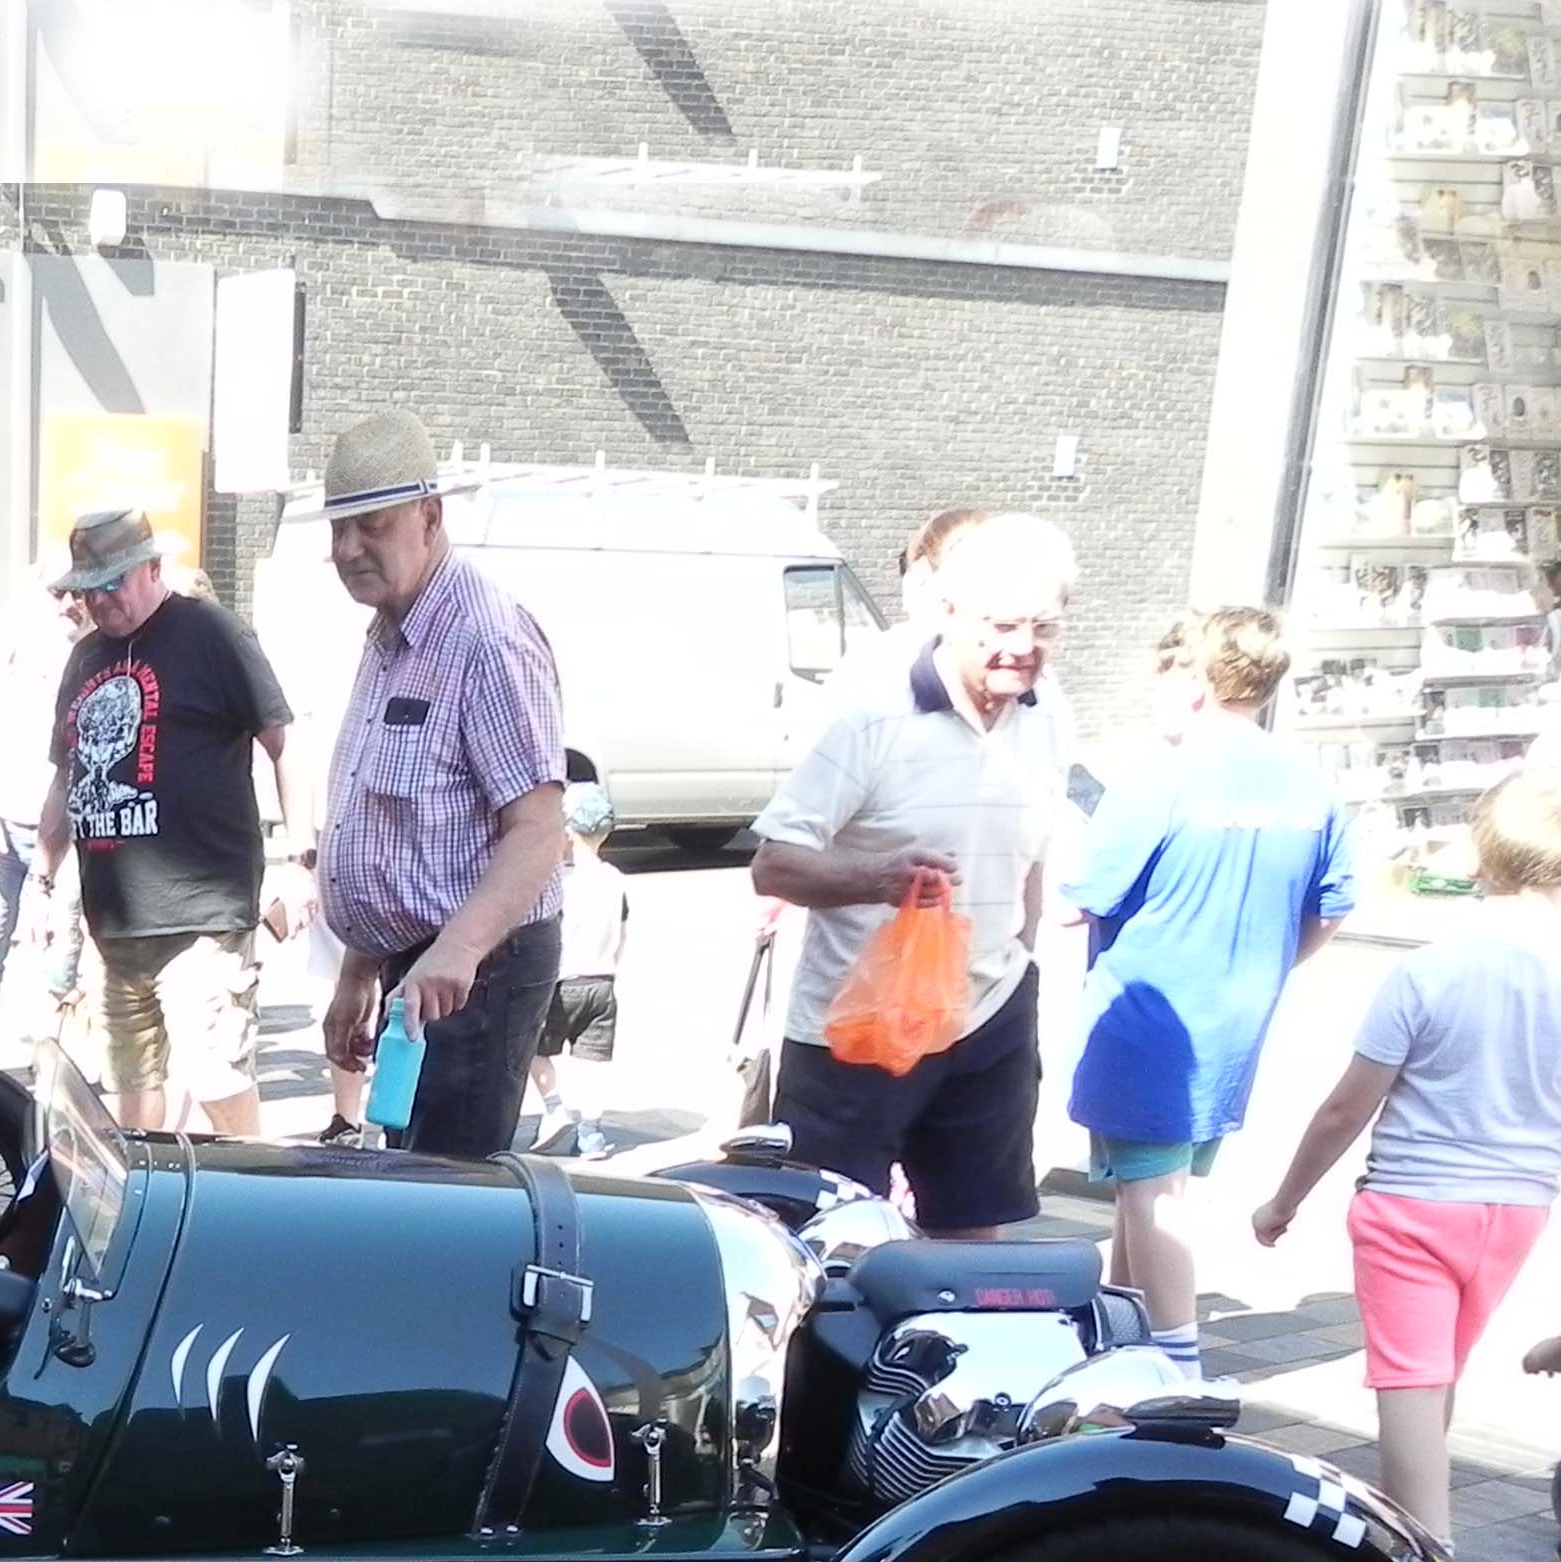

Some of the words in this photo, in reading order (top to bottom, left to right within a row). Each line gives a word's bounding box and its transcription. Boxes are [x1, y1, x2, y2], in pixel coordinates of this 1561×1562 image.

[138, 725, 156, 783] ESCAPE
[86, 811, 116, 838] THE
[120, 799, 158, 837] BAR
